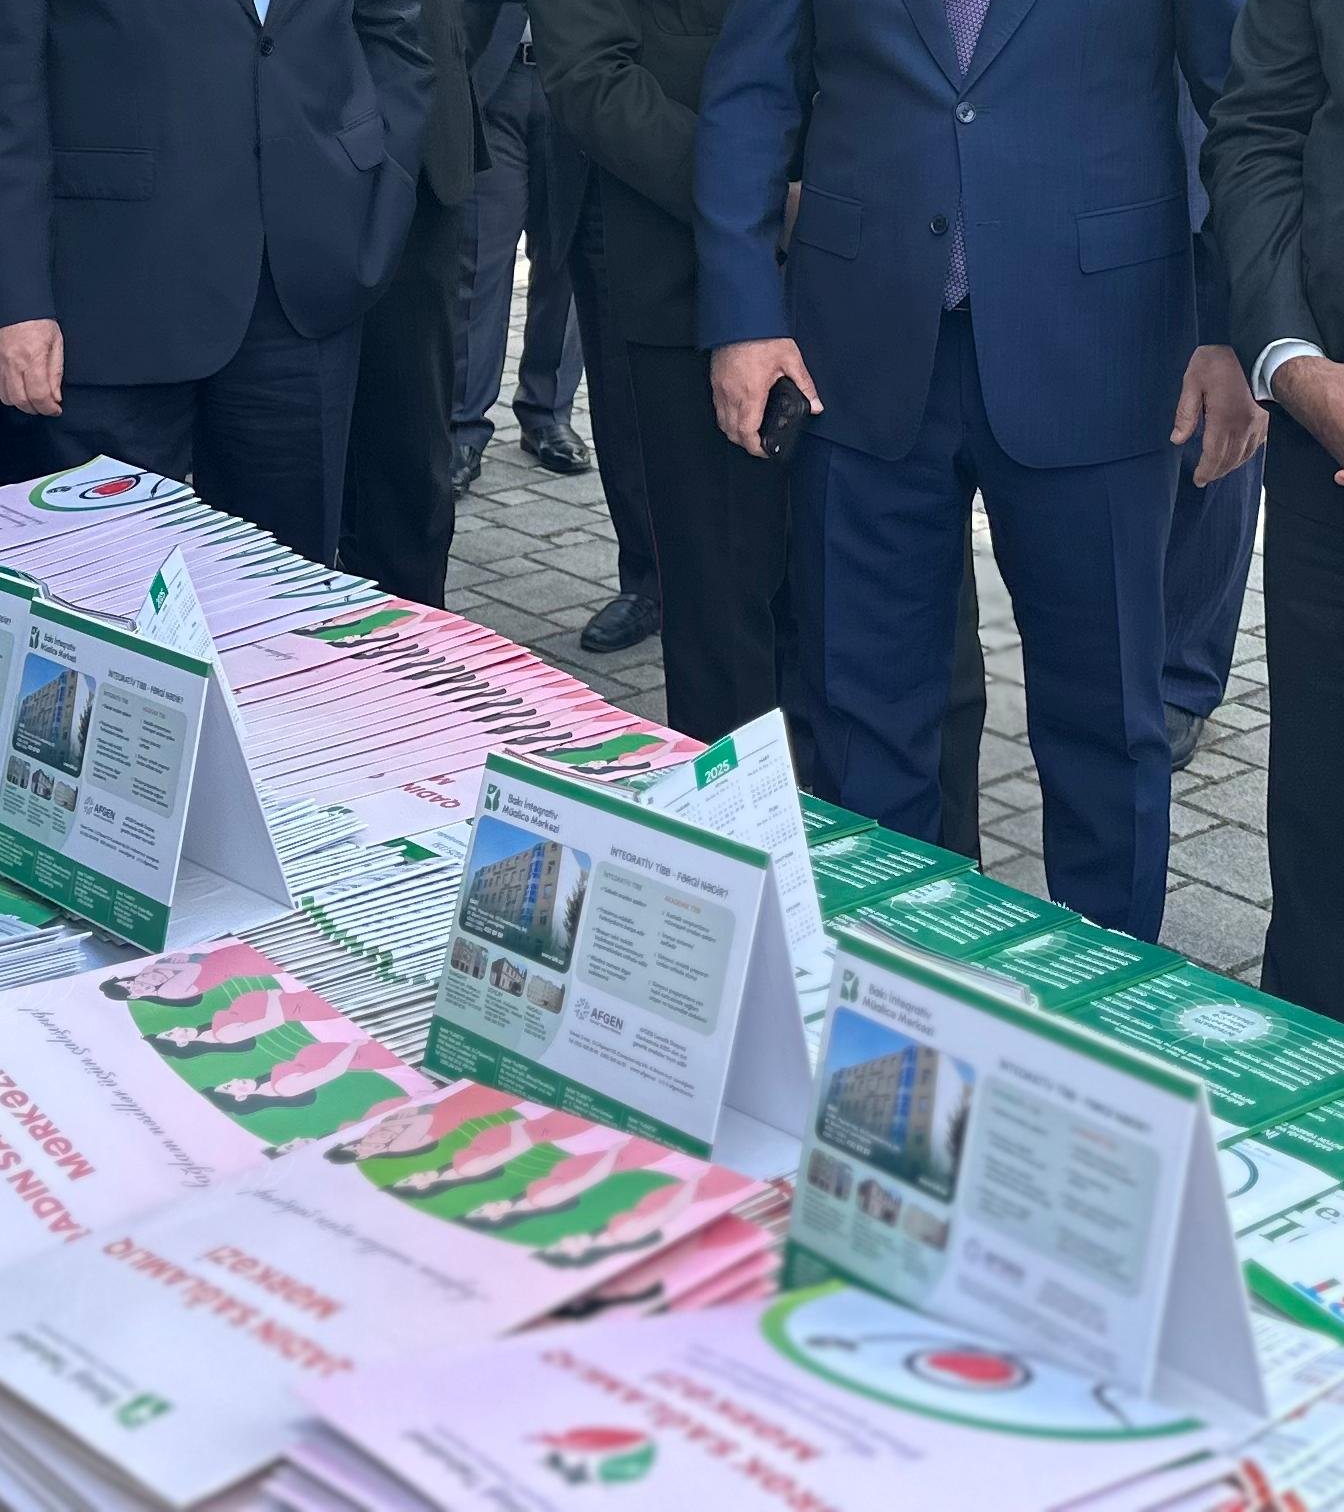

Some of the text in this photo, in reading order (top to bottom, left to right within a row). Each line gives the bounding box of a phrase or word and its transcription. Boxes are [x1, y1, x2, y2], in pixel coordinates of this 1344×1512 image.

[704, 760, 731, 783] 2025
[590, 1006, 624, 1029] AFGEN
[80, 1056, 118, 1087] üçün
[111, 1089, 164, 1135] nəsillər
[99, 1232, 262, 1325] SAĞLAMLIQ
[195, 1236, 345, 1322] MƏRKƏZİ
